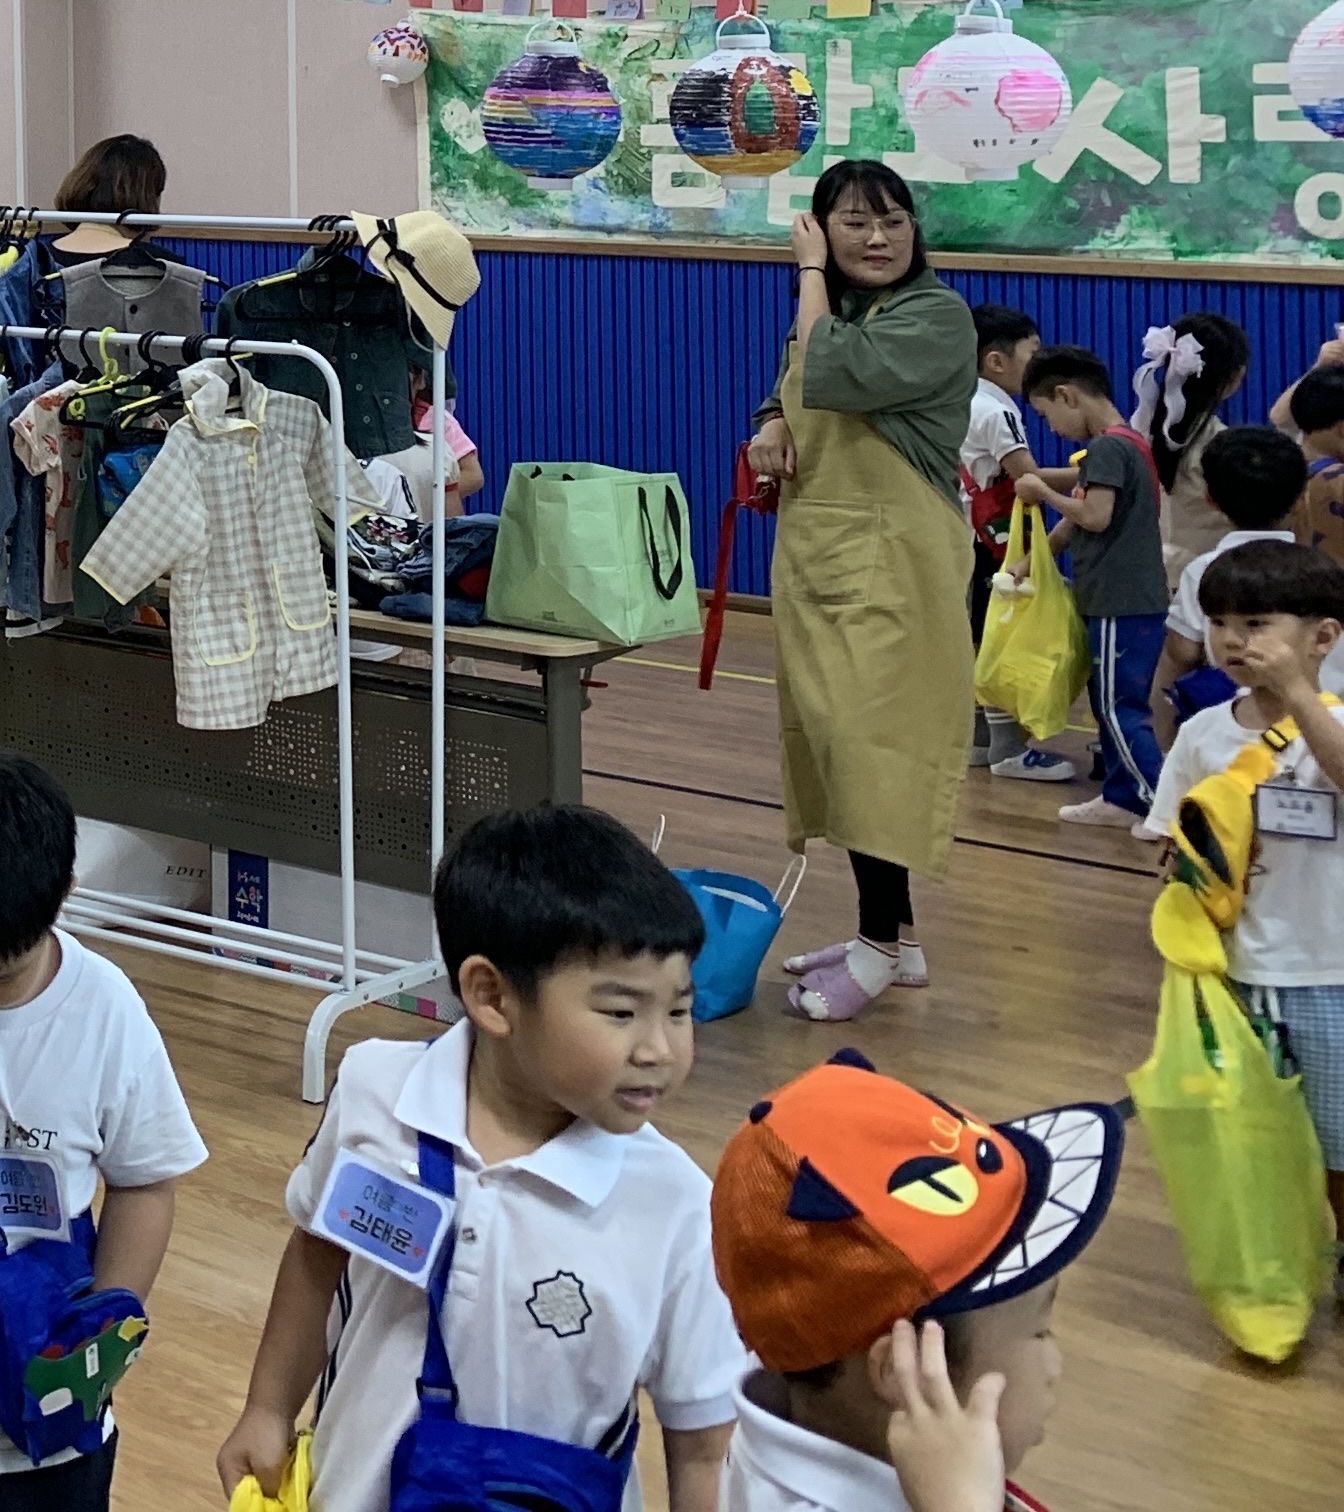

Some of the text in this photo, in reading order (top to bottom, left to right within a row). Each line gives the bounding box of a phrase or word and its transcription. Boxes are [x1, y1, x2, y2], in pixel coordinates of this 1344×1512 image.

[165, 865, 207, 878] EDIT
[235, 886, 263, 913] 수학
[0, 1192, 49, 1217] 김도원
